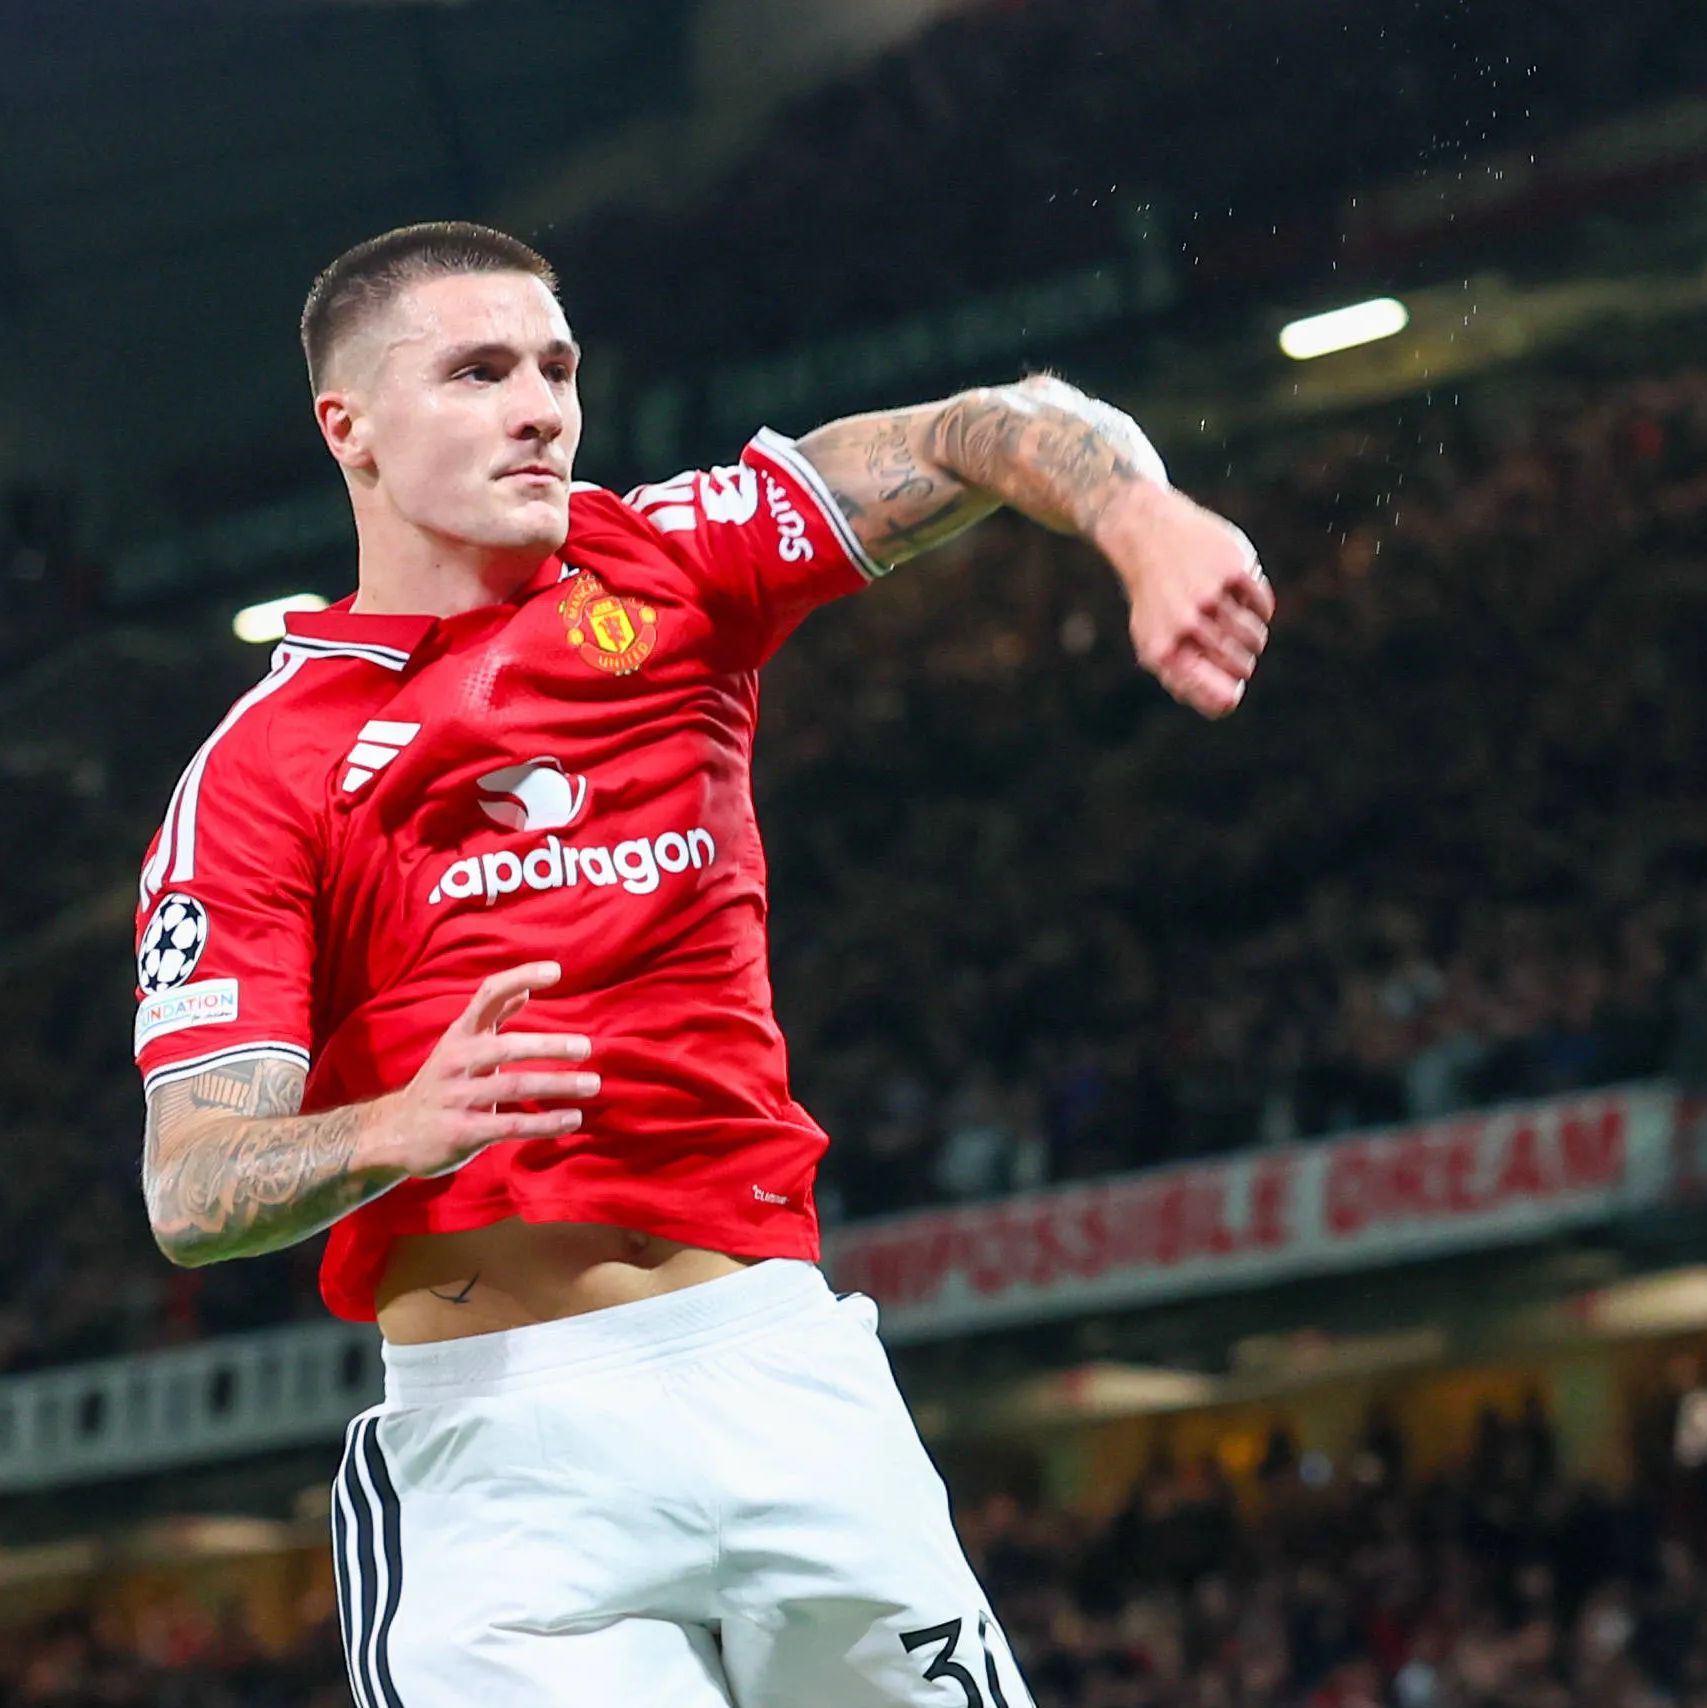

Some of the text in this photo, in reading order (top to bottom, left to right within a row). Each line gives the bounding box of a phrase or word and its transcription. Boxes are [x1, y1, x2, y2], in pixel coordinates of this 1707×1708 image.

[598, 641, 649, 668] UNITED
[428, 828, 715, 906] apdragon
[140, 993, 234, 1027] UNDATION
[1323, 1103, 1627, 1236] DREAM
